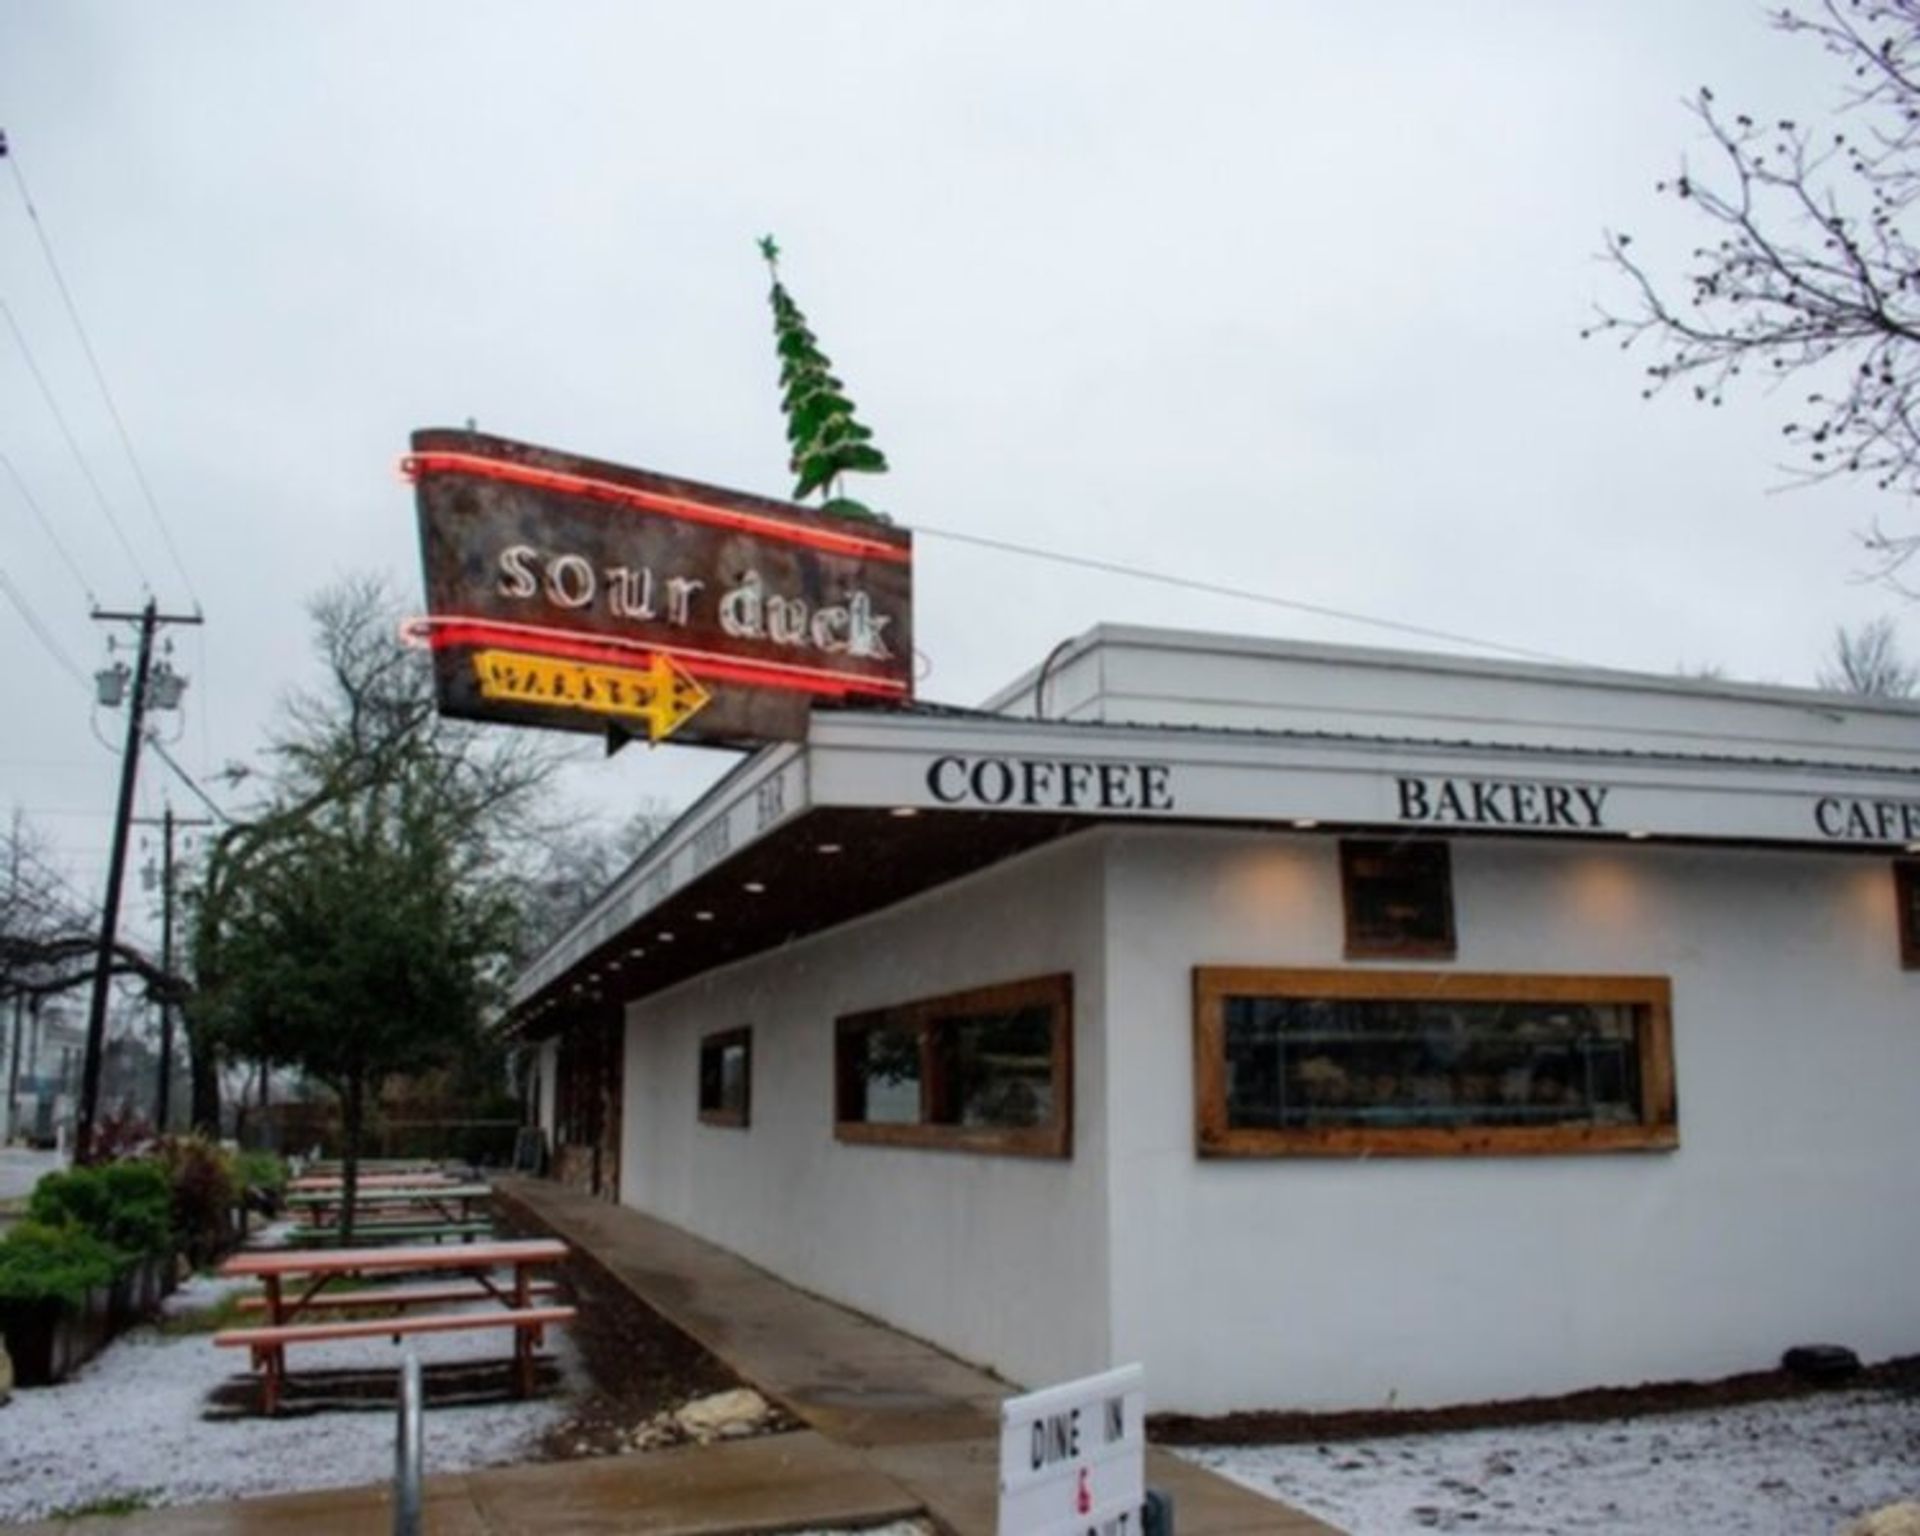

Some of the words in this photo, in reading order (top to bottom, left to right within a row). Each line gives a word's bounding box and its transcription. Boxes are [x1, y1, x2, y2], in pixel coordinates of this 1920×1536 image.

[498, 545, 703, 627] sour
[719, 569, 894, 661] duck
[926, 755, 1174, 811] COFFEE
[1394, 777, 1609, 827] BAKERY
[1030, 1408, 1080, 1470] DINE
[1103, 1397, 1124, 1443] IN
